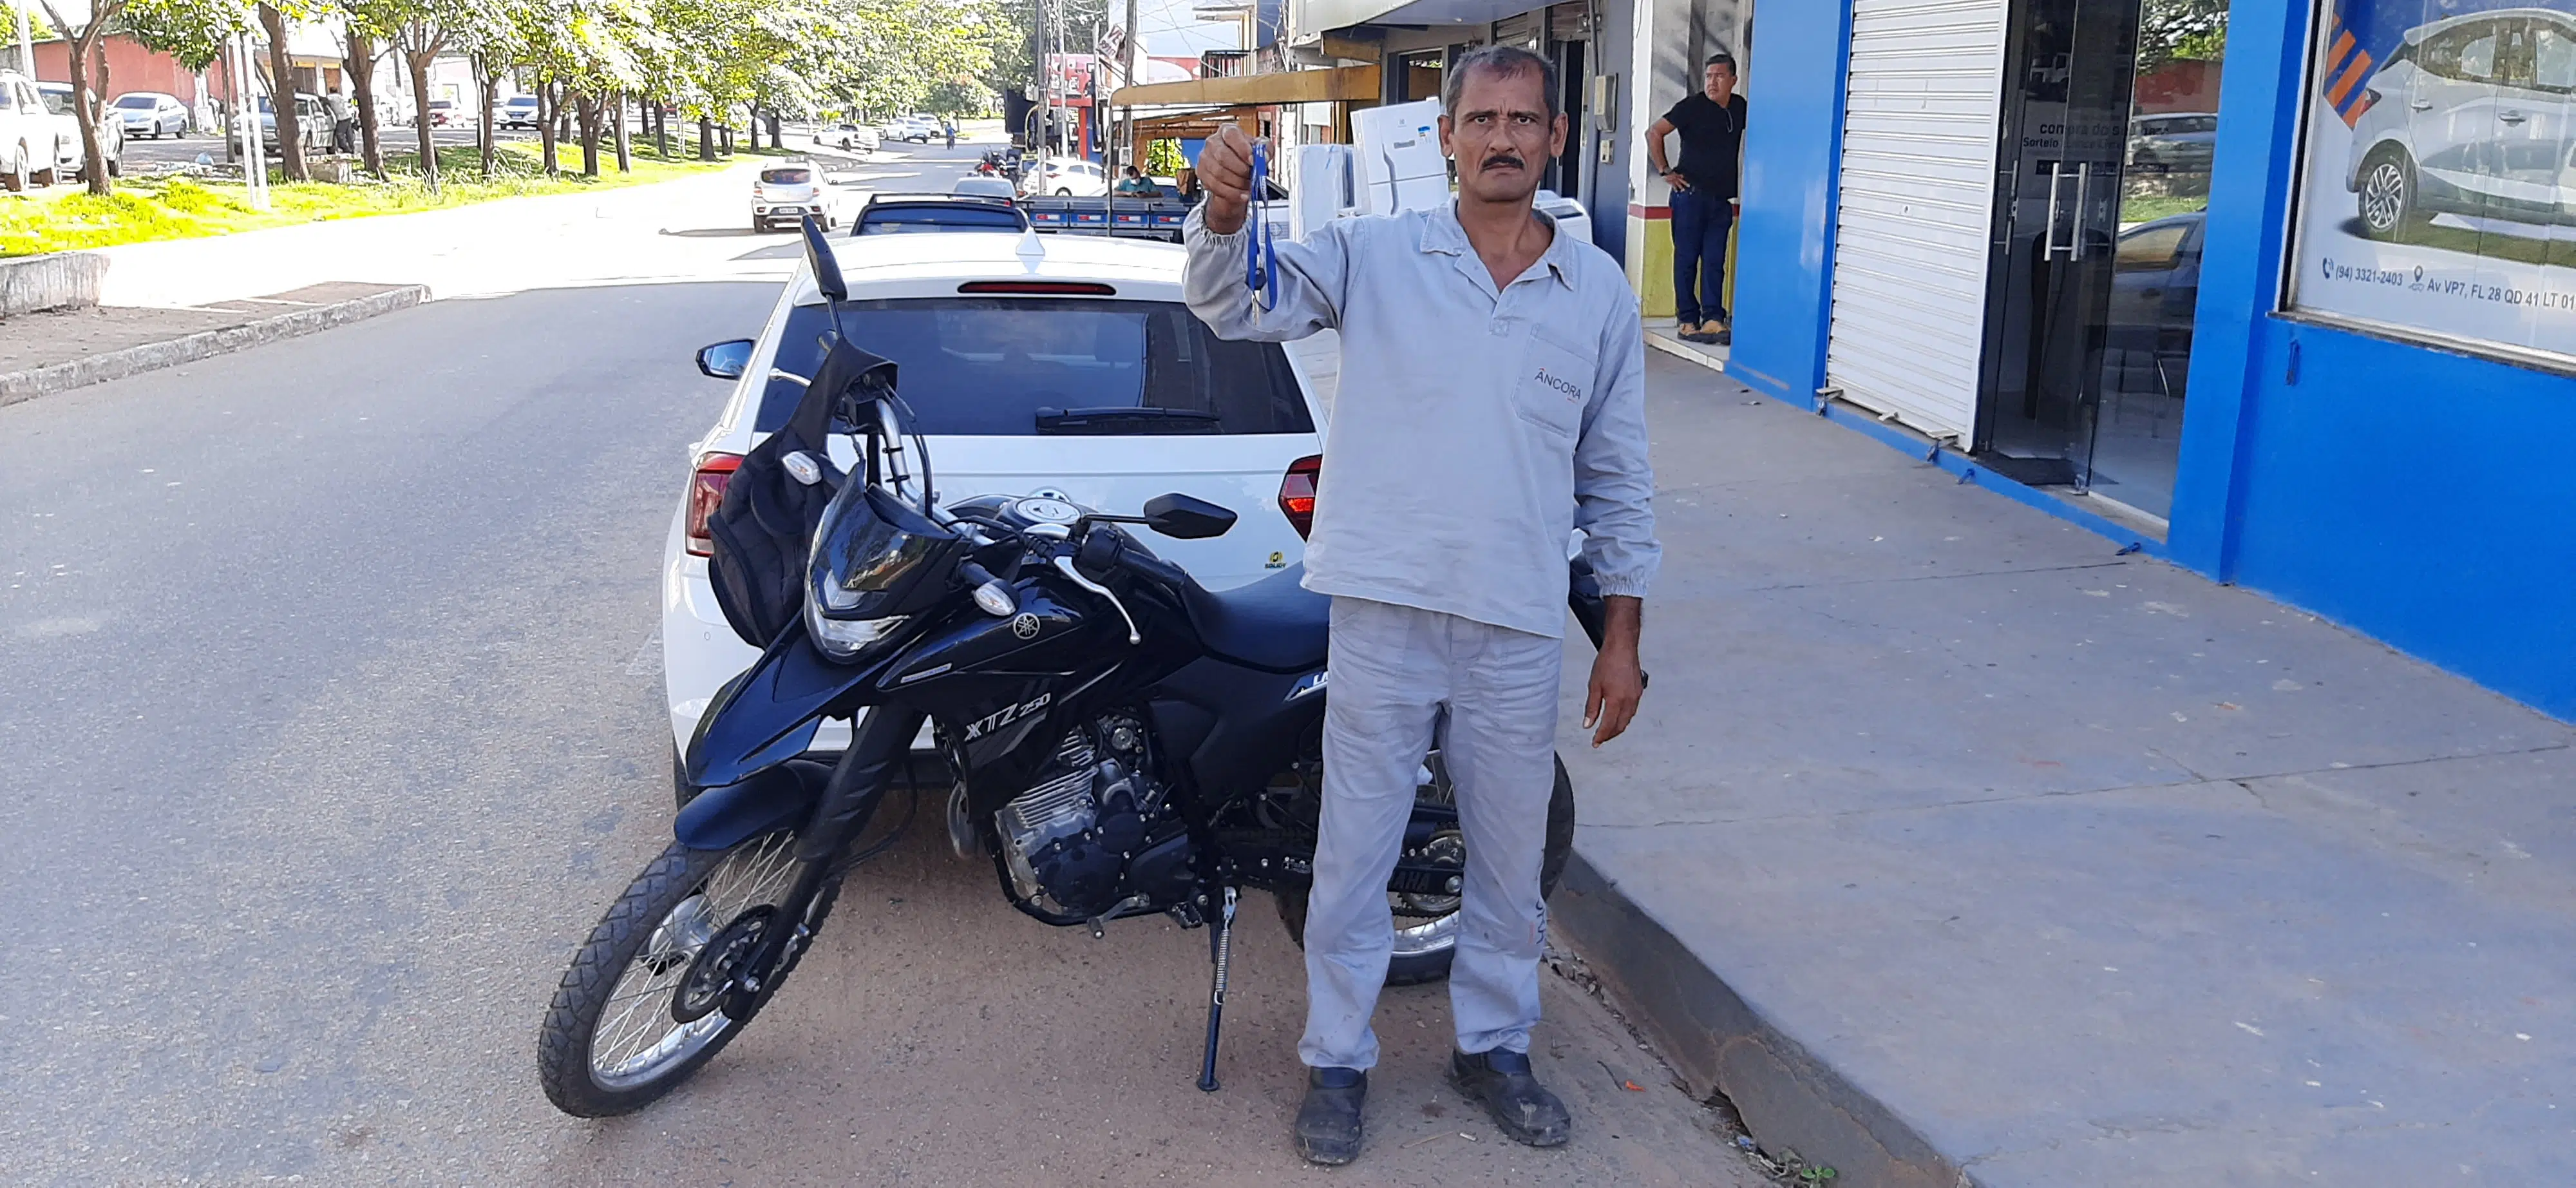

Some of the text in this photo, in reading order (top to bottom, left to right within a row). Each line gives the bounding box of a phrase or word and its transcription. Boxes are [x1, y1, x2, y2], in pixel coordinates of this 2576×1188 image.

[2023, 137, 2059, 148] Sorteio
[2336, 265, 2575, 310] (94) 3321-2403 Av VP7, FL 28 QD 41 LT 01
[965, 693, 1051, 742] XTZ 250
